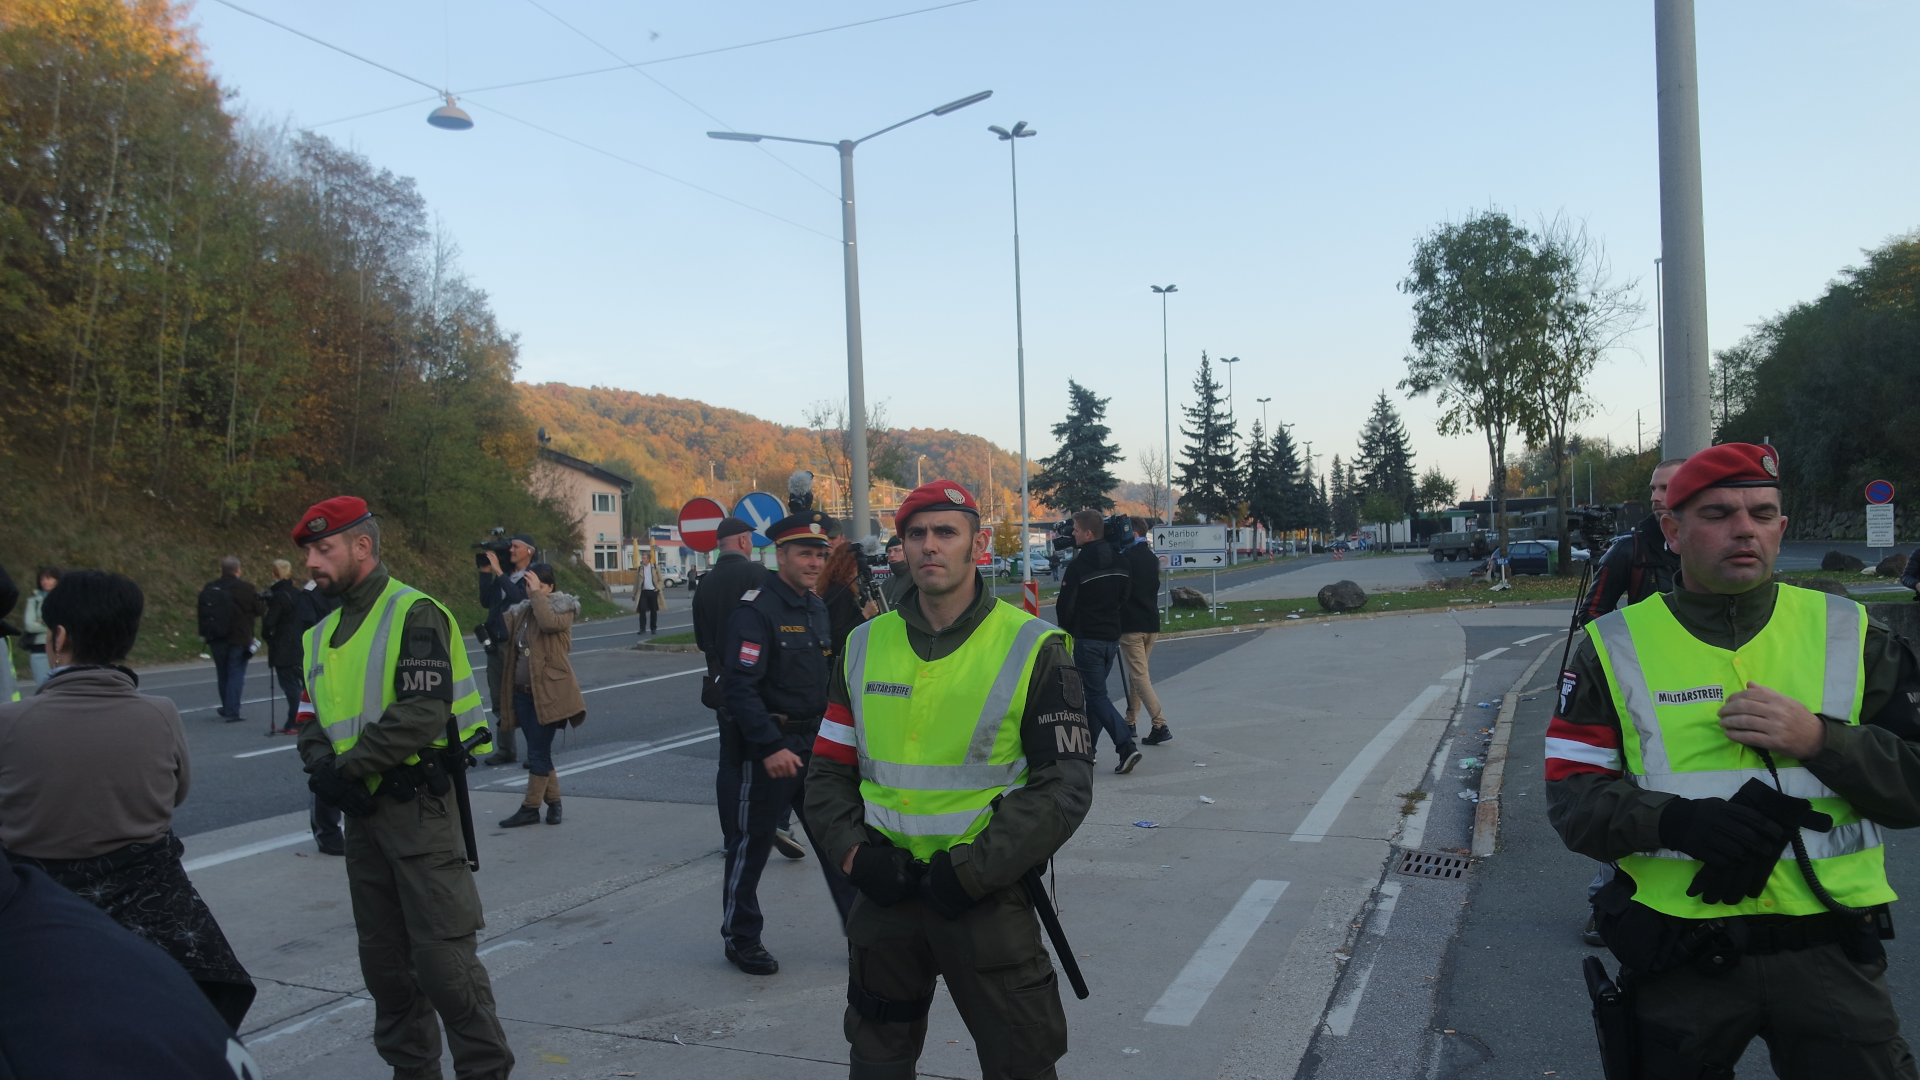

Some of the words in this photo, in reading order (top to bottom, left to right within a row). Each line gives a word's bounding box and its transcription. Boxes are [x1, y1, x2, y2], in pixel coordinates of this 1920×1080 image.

[1168, 530, 1198, 538] Maribor
[402, 670, 442, 691] MP
[866, 683, 909, 696] MILITÄRSTREIFE
[1658, 688, 1723, 703] MILITÄRSTREIFE
[1055, 725, 1092, 755] MP
